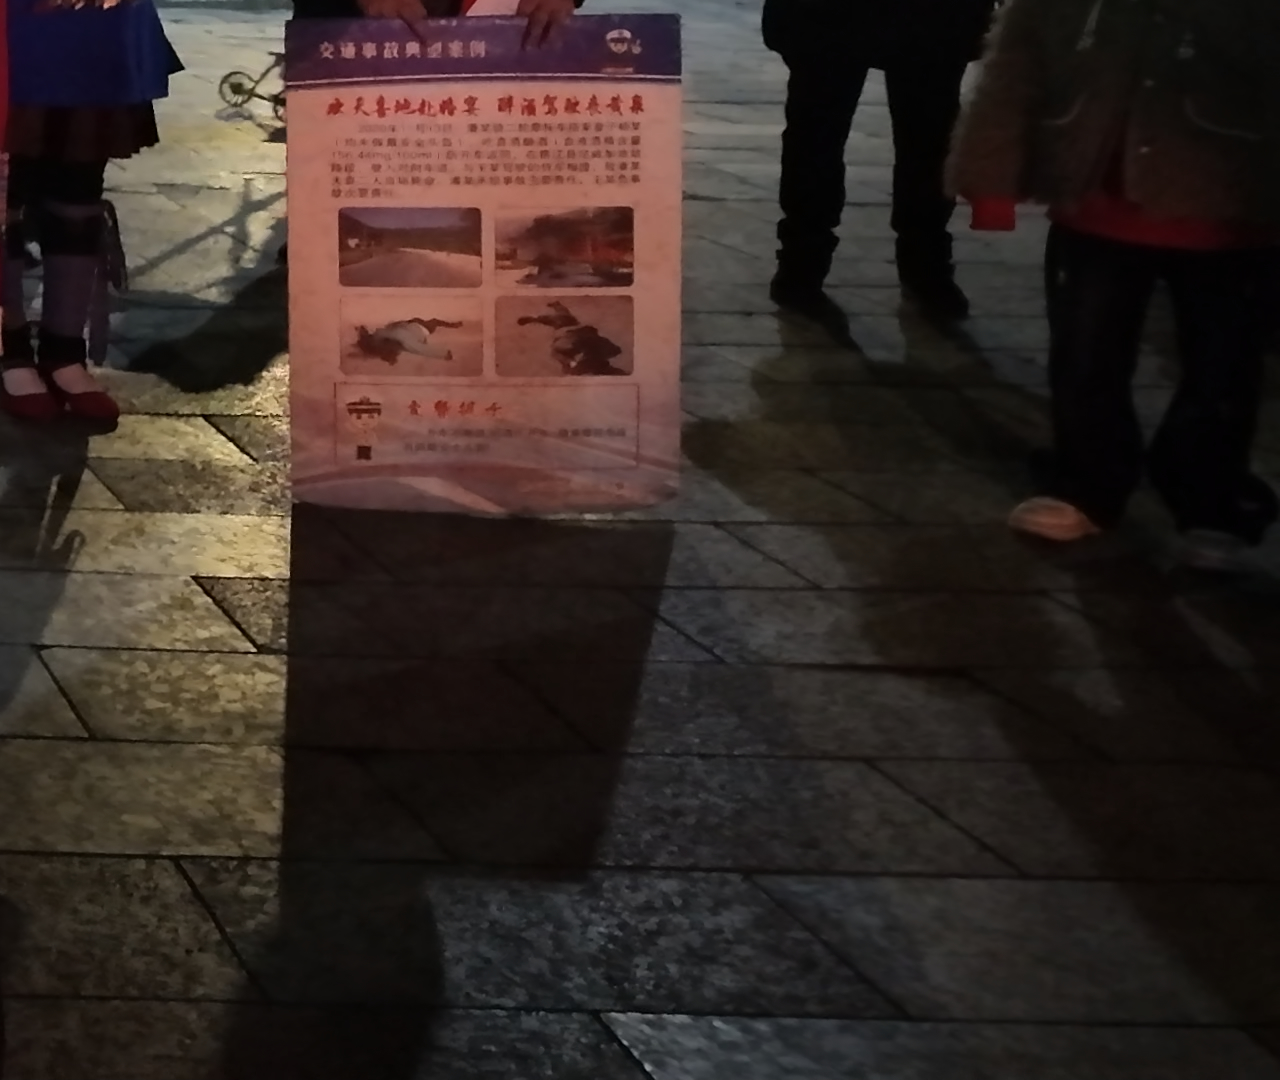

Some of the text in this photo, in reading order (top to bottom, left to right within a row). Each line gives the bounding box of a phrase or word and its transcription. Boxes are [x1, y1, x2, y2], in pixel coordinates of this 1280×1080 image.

[319, 40, 486, 59] 交通事故典型案例
